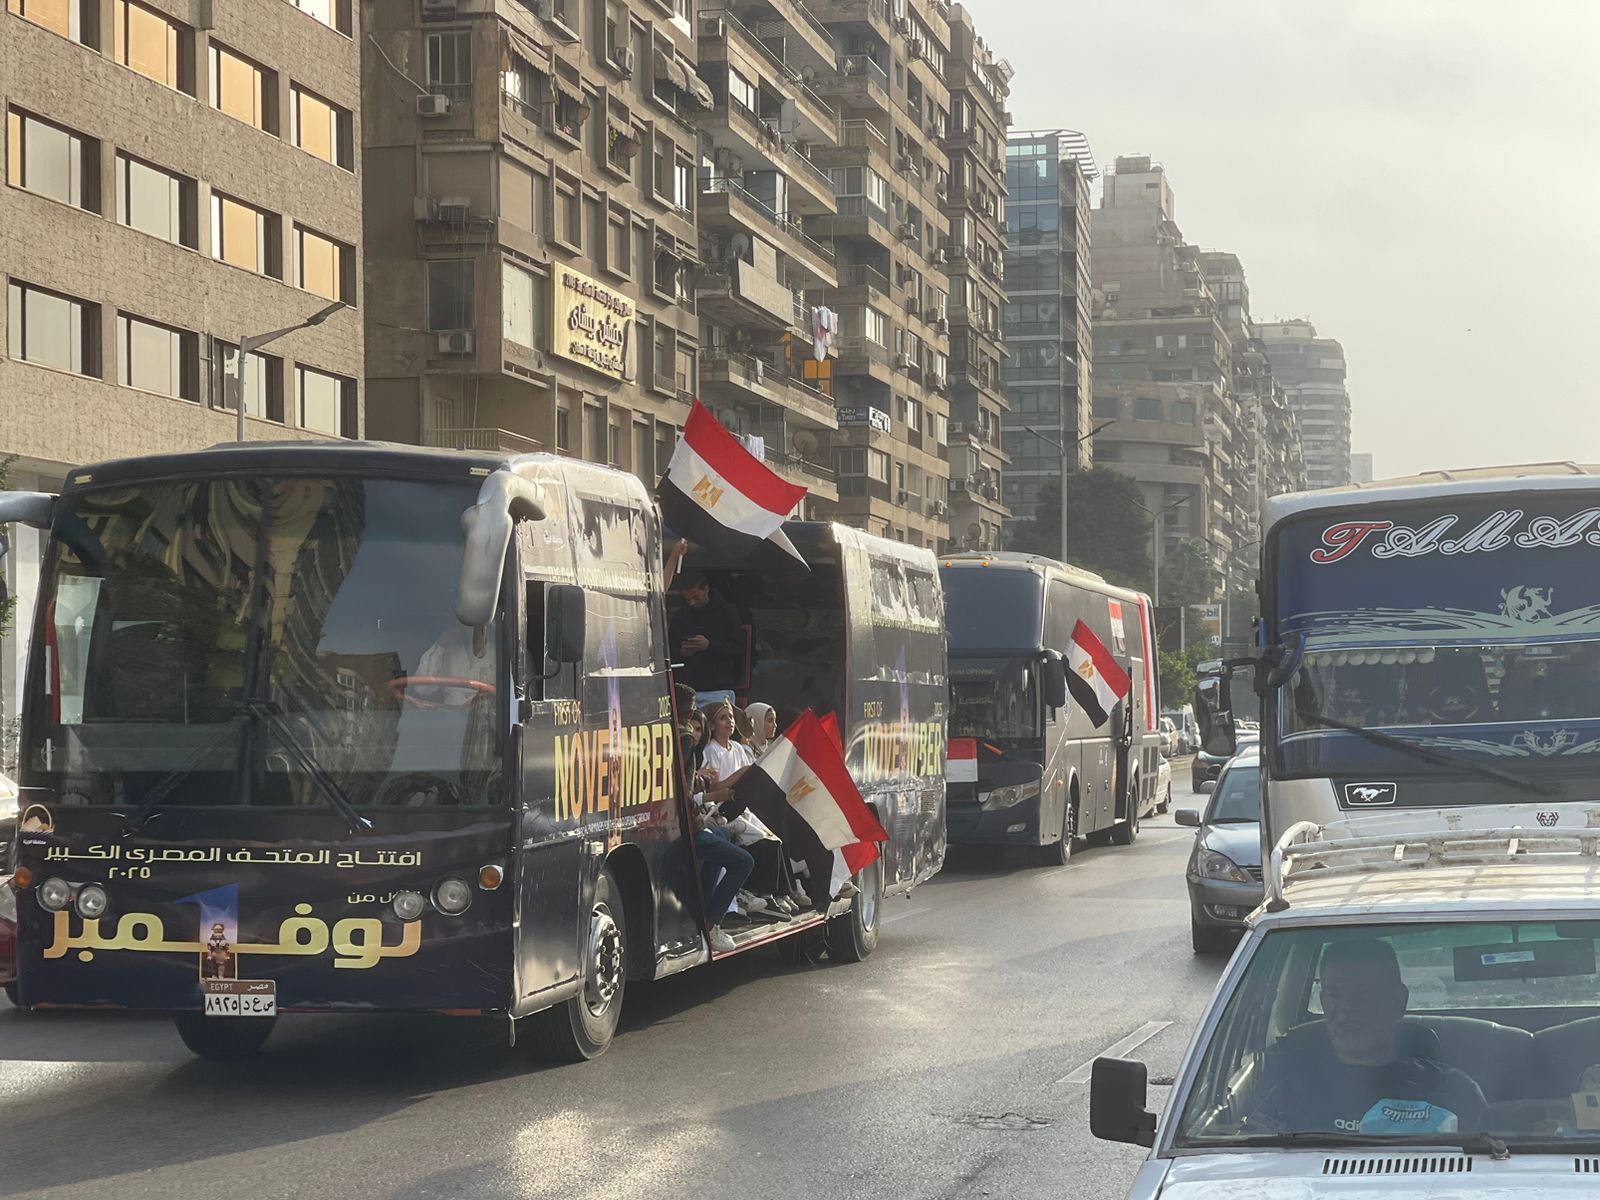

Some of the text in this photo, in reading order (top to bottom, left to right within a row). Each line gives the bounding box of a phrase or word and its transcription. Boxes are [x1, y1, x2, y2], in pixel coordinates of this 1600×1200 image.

[1310, 507, 1600, 564] TAMA
[1200, 608, 1219, 617] obil
[554, 700, 582, 726] FIRST OF
[863, 701, 883, 718] FIRST OF
[862, 722, 942, 784] NOVEMBER
[554, 723, 674, 822] NOVEMBER
[44, 845, 120, 861] الكبير
[226, 847, 330, 864] المتحف
[336, 850, 422, 868] افتتاح
[108, 866, 152, 880] ٢٠٢٥
[347, 892, 375, 904] من
[210, 983, 233, 991] EGYPT
[247, 983, 269, 992] مصر
[206, 996, 238, 1013] ٨٩٢٥
[1334, 1118, 1360, 1131] adi
